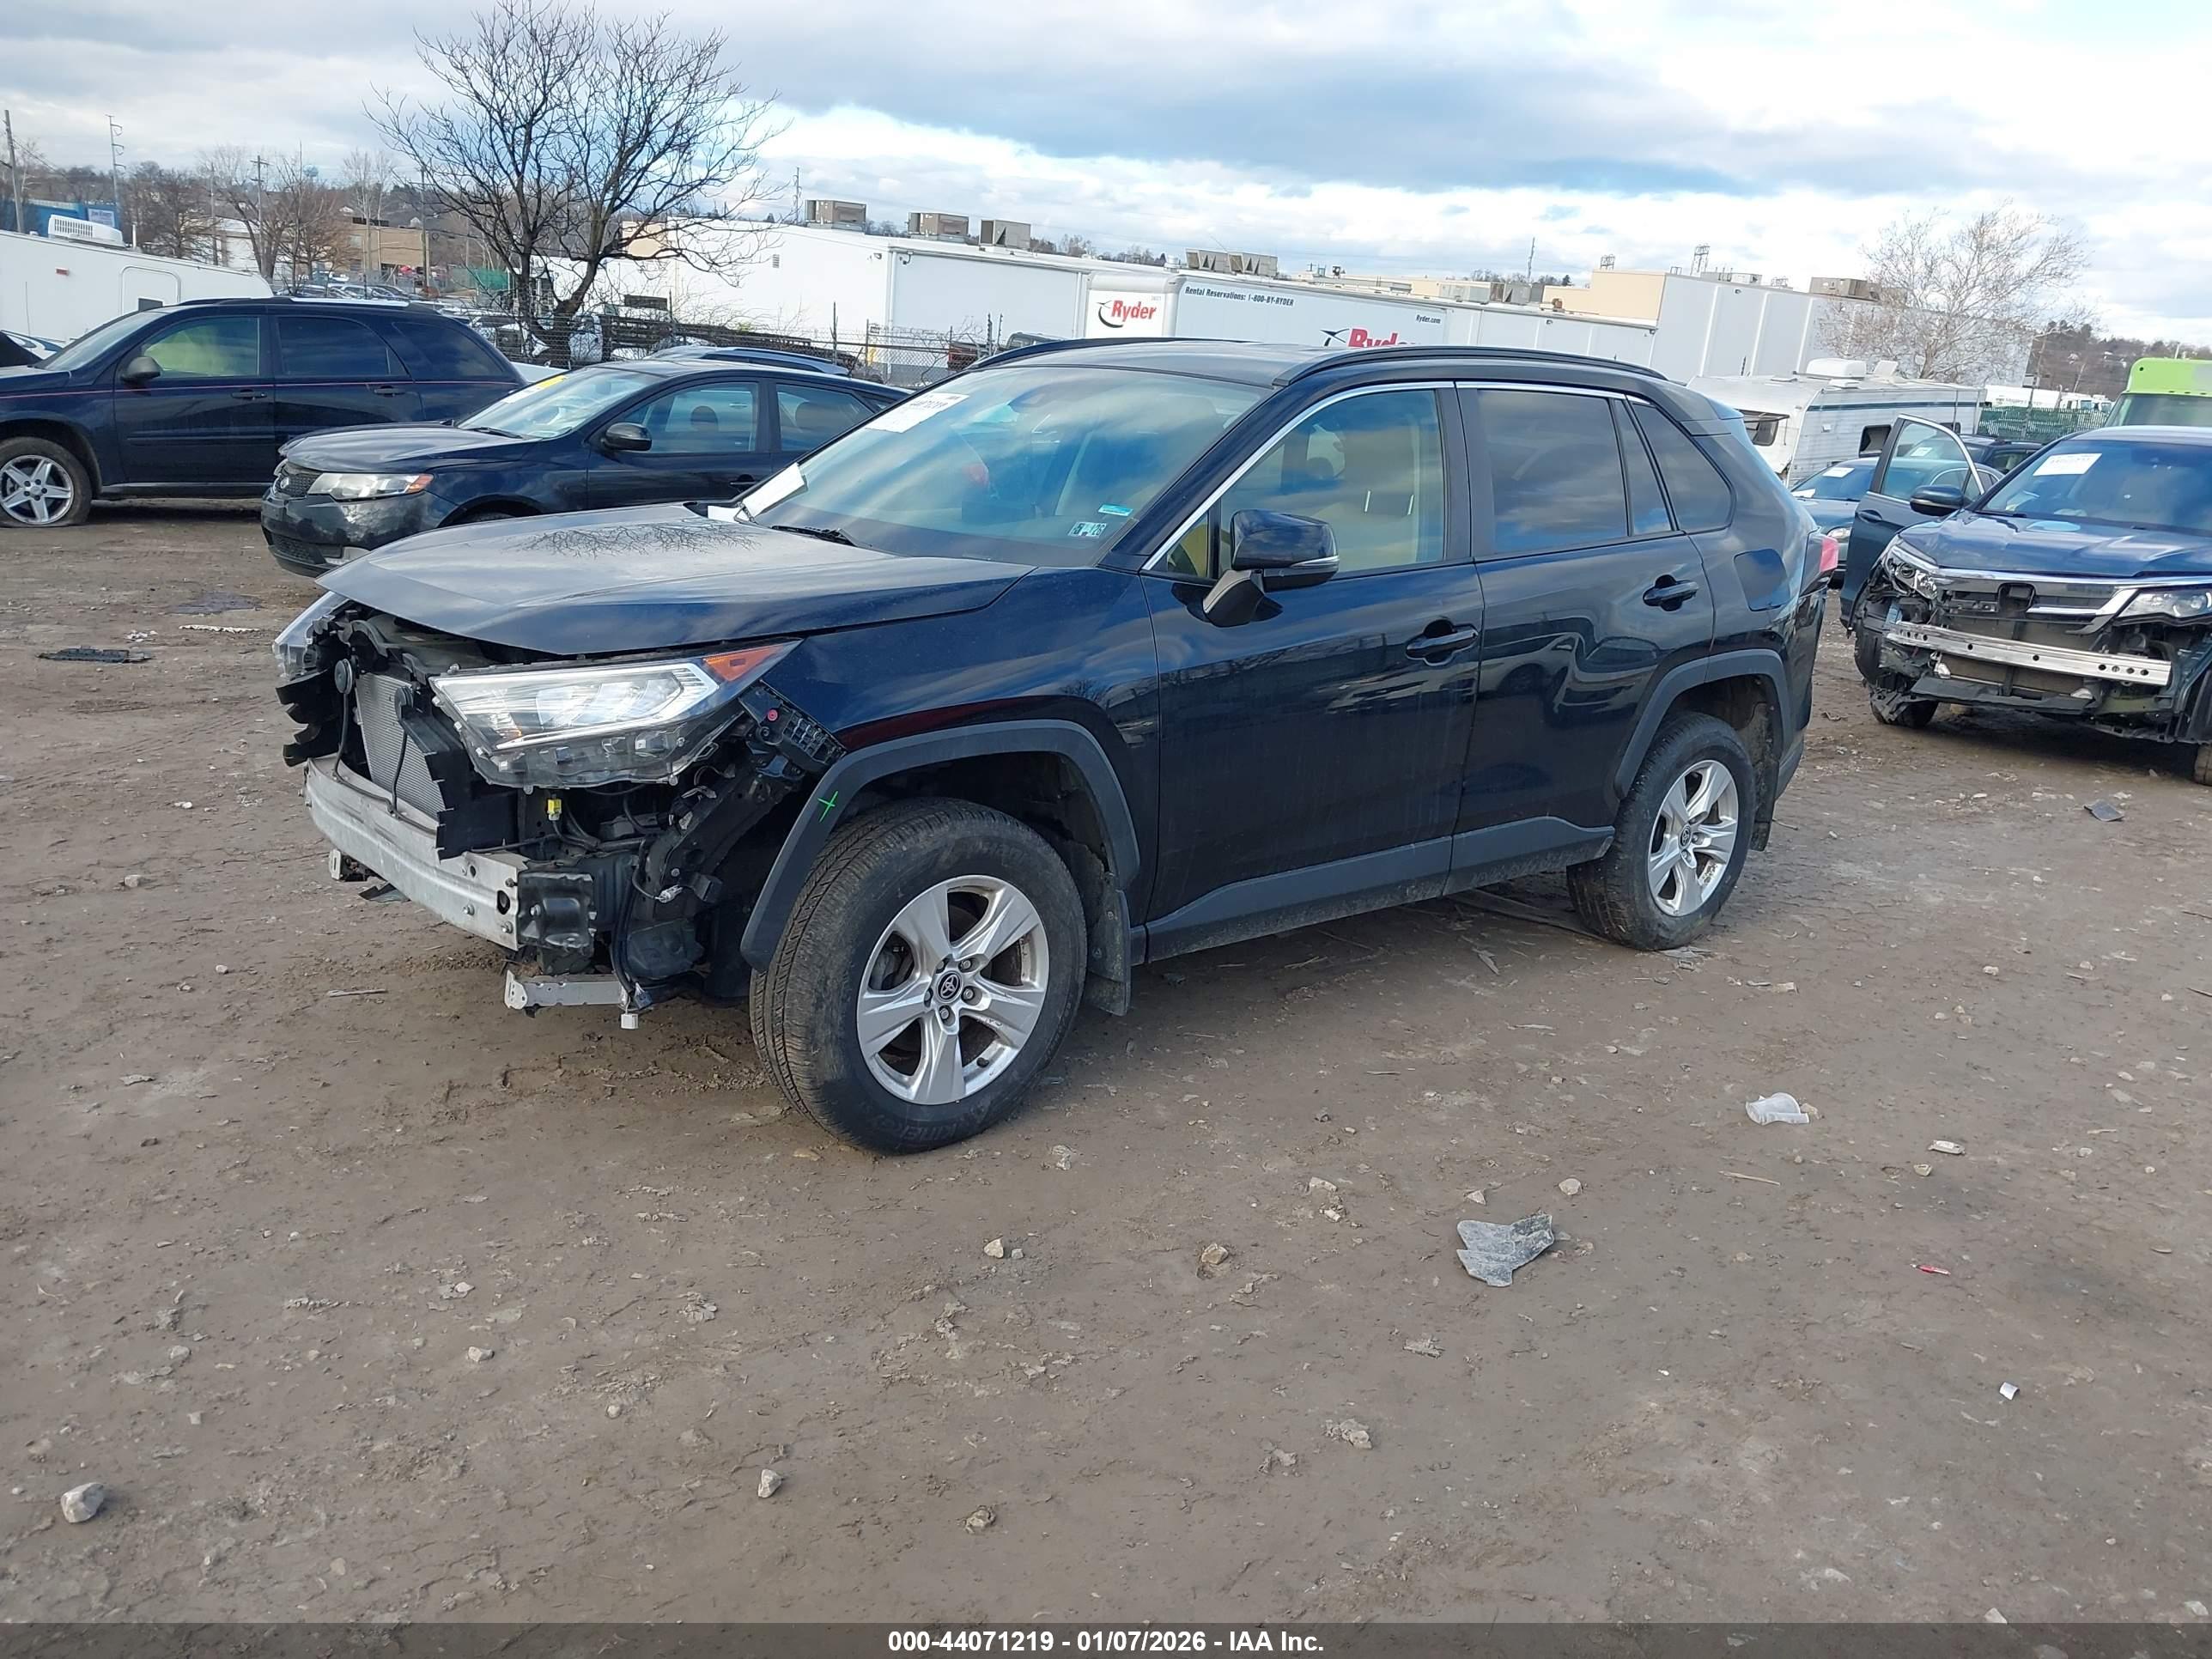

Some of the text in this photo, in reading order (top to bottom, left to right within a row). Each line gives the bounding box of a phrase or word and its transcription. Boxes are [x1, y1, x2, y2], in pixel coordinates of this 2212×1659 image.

[1185, 286, 1205, 296] Rental
[1206, 289, 1246, 301] Reservations:
[1111, 300, 1157, 322] Ryder
[1416, 314, 1441, 324] Ryder.com
